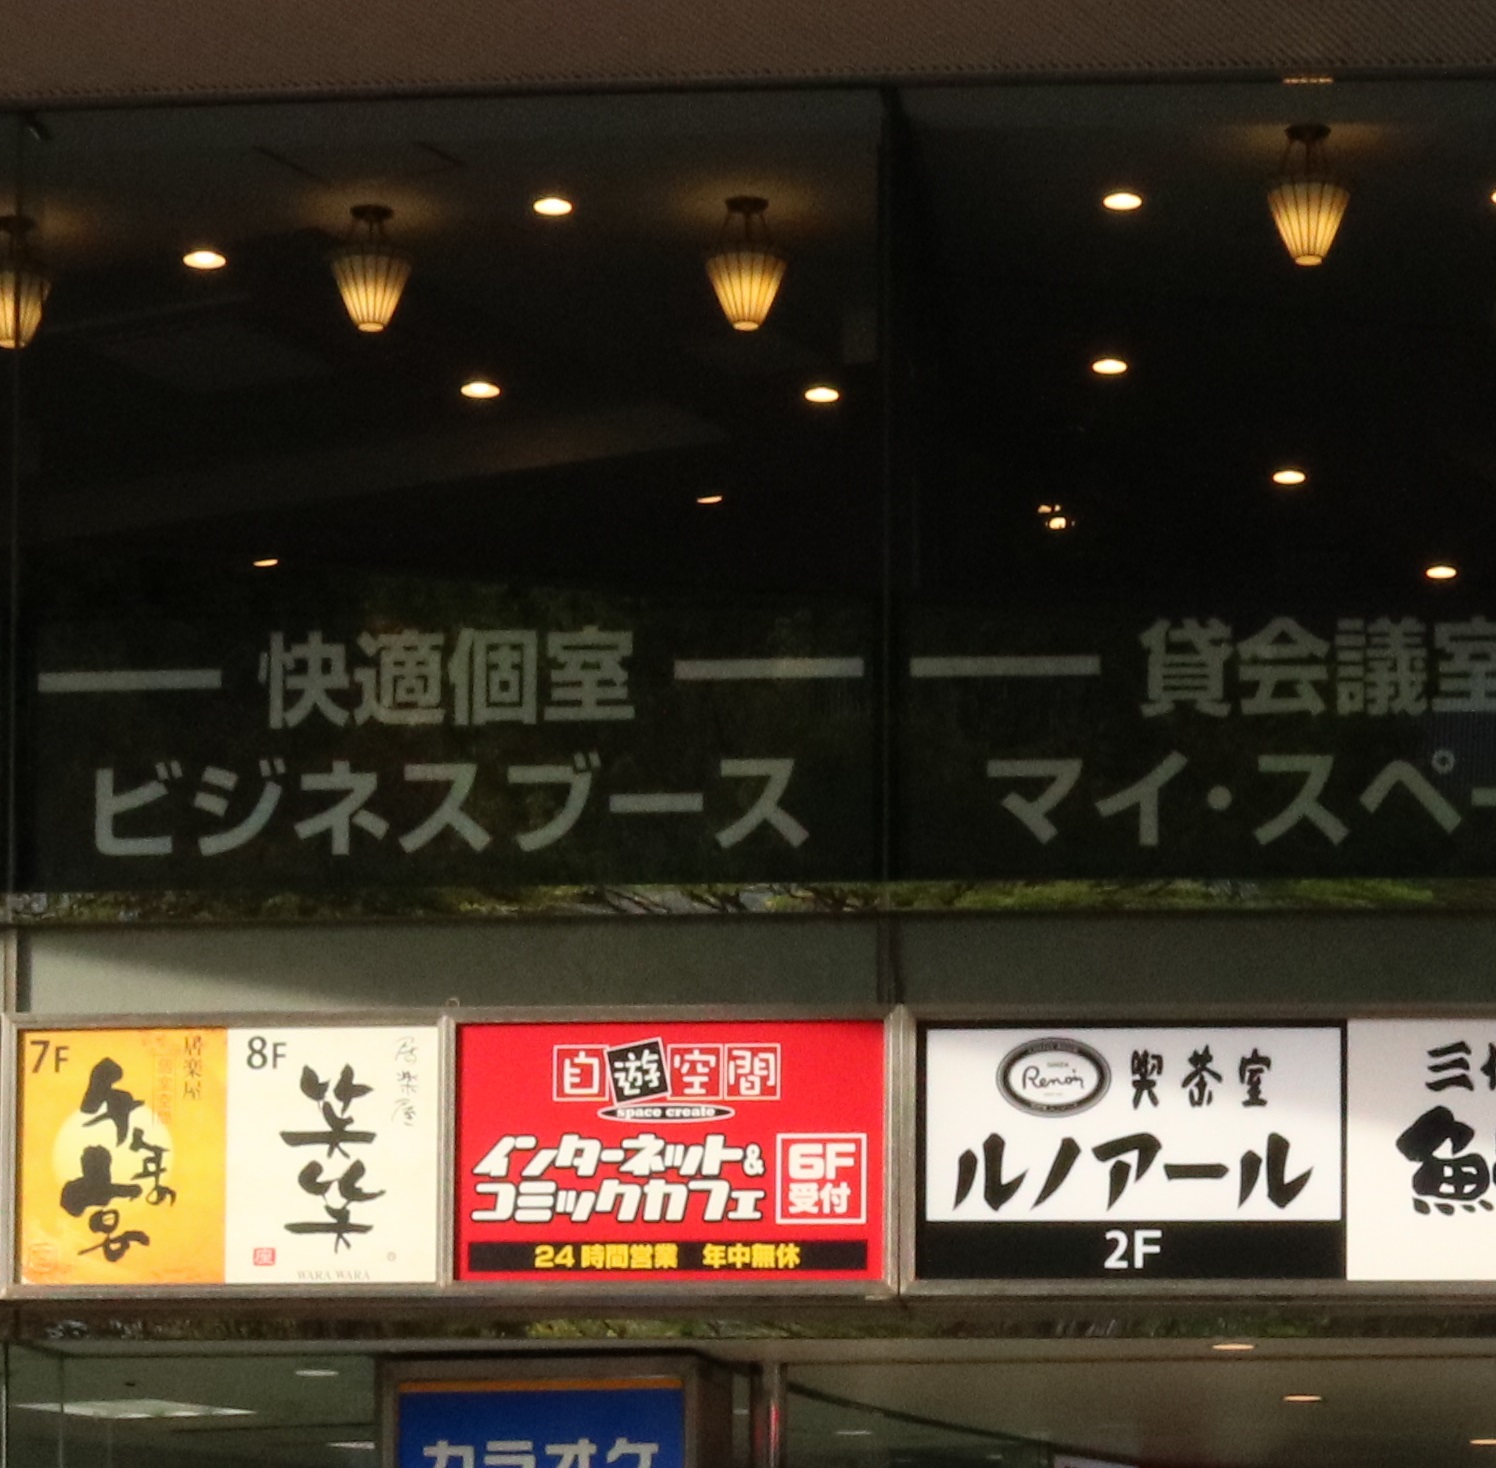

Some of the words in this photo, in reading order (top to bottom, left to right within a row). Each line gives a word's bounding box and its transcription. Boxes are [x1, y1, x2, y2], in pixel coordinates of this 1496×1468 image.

[260, 626, 637, 728] 快適個室
[91, 752, 808, 858] ビジネスブース
[30, 1041, 69, 1073] 7F
[247, 1036, 287, 1069] 8F
[561, 1046, 777, 1097] 自遊空間
[1130, 1045, 1272, 1109] 喫茶室
[617, 1106, 662, 1119] space
[666, 1105, 715, 1118] create
[279, 1064, 385, 1254] 笑笑
[472, 1133, 765, 1177] インターネット&
[789, 1142, 855, 1179] 6F
[953, 1132, 1314, 1211] ルノアール
[471, 1178, 765, 1223] コミックカフェ
[788, 1183, 851, 1214] 受付
[703, 1244, 800, 1268] 年中無休
[1105, 1228, 1162, 1270] 2F
[297, 1271, 332, 1280] WARA
[336, 1270, 370, 1280] WARA
